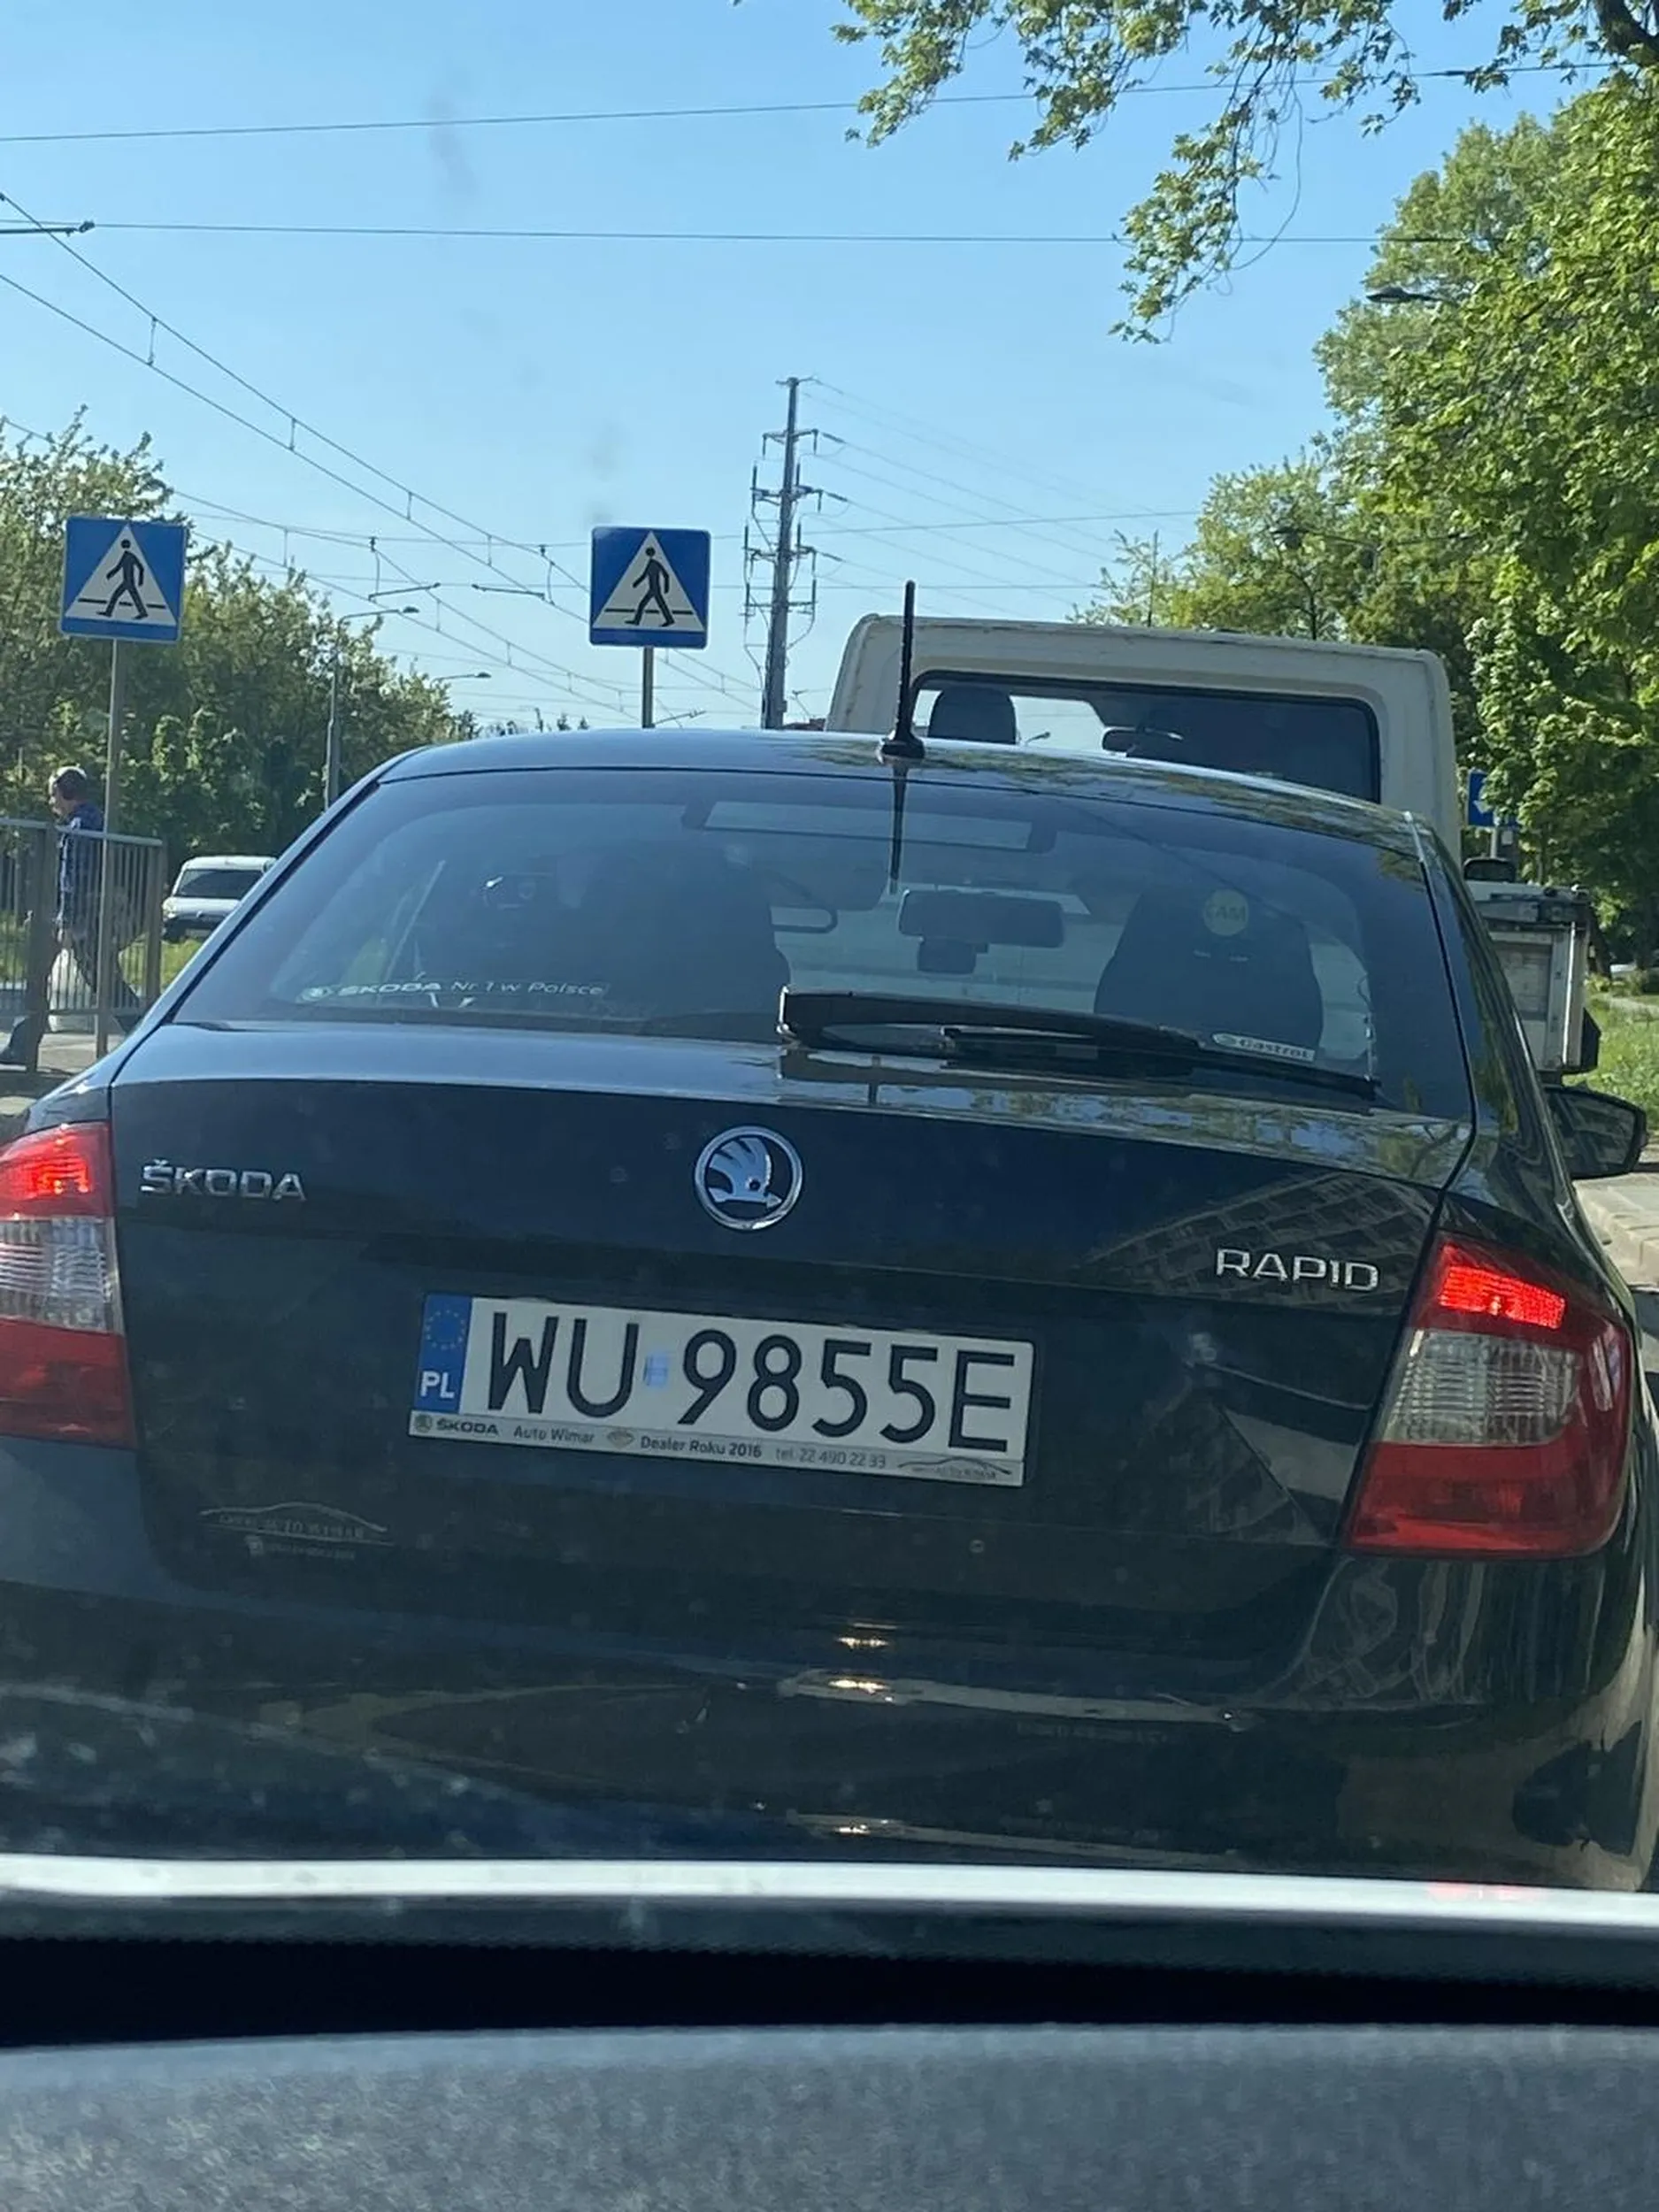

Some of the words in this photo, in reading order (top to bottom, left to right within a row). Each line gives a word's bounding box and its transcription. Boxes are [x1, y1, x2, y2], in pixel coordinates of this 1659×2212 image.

[451, 981, 478, 992] Nr
[528, 983, 603, 995] Polsce
[141, 1159, 306, 1201] ŠKODA
[1217, 1248, 1379, 1291] RAPID
[420, 1371, 456, 1399] PL
[488, 1312, 639, 1418] WU
[678, 1329, 1015, 1453] 9855E
[513, 1425, 546, 1439] Auto
[550, 1429, 595, 1444] Wimar
[641, 1435, 685, 1451] Dealer
[689, 1440, 726, 1455] Roku
[729, 1443, 762, 1458] 2016
[799, 1448, 817, 1462] 22
[819, 1450, 847, 1464] 490
[849, 1454, 867, 1466] 22
[869, 1455, 886, 1469] 33
